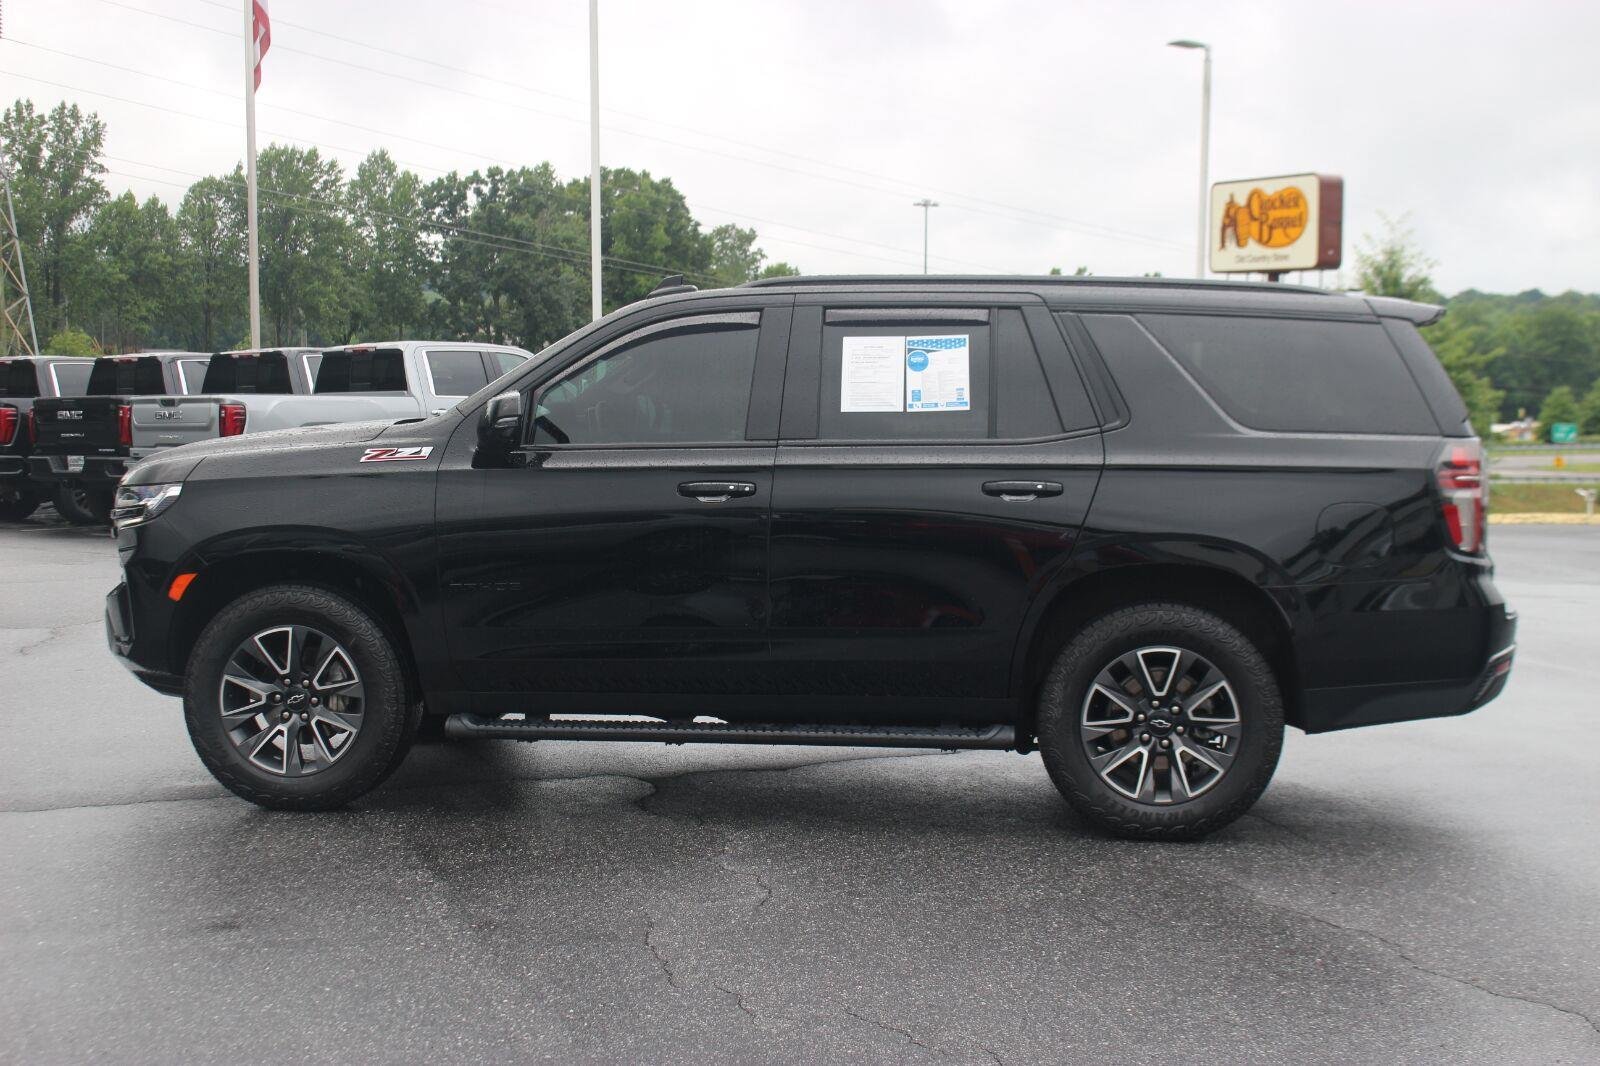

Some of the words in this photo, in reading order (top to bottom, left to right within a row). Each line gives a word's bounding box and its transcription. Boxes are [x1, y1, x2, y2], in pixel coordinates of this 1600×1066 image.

[57, 410, 83, 419] GMC
[155, 410, 182, 420] GMC
[360, 447, 434, 463] Z71
